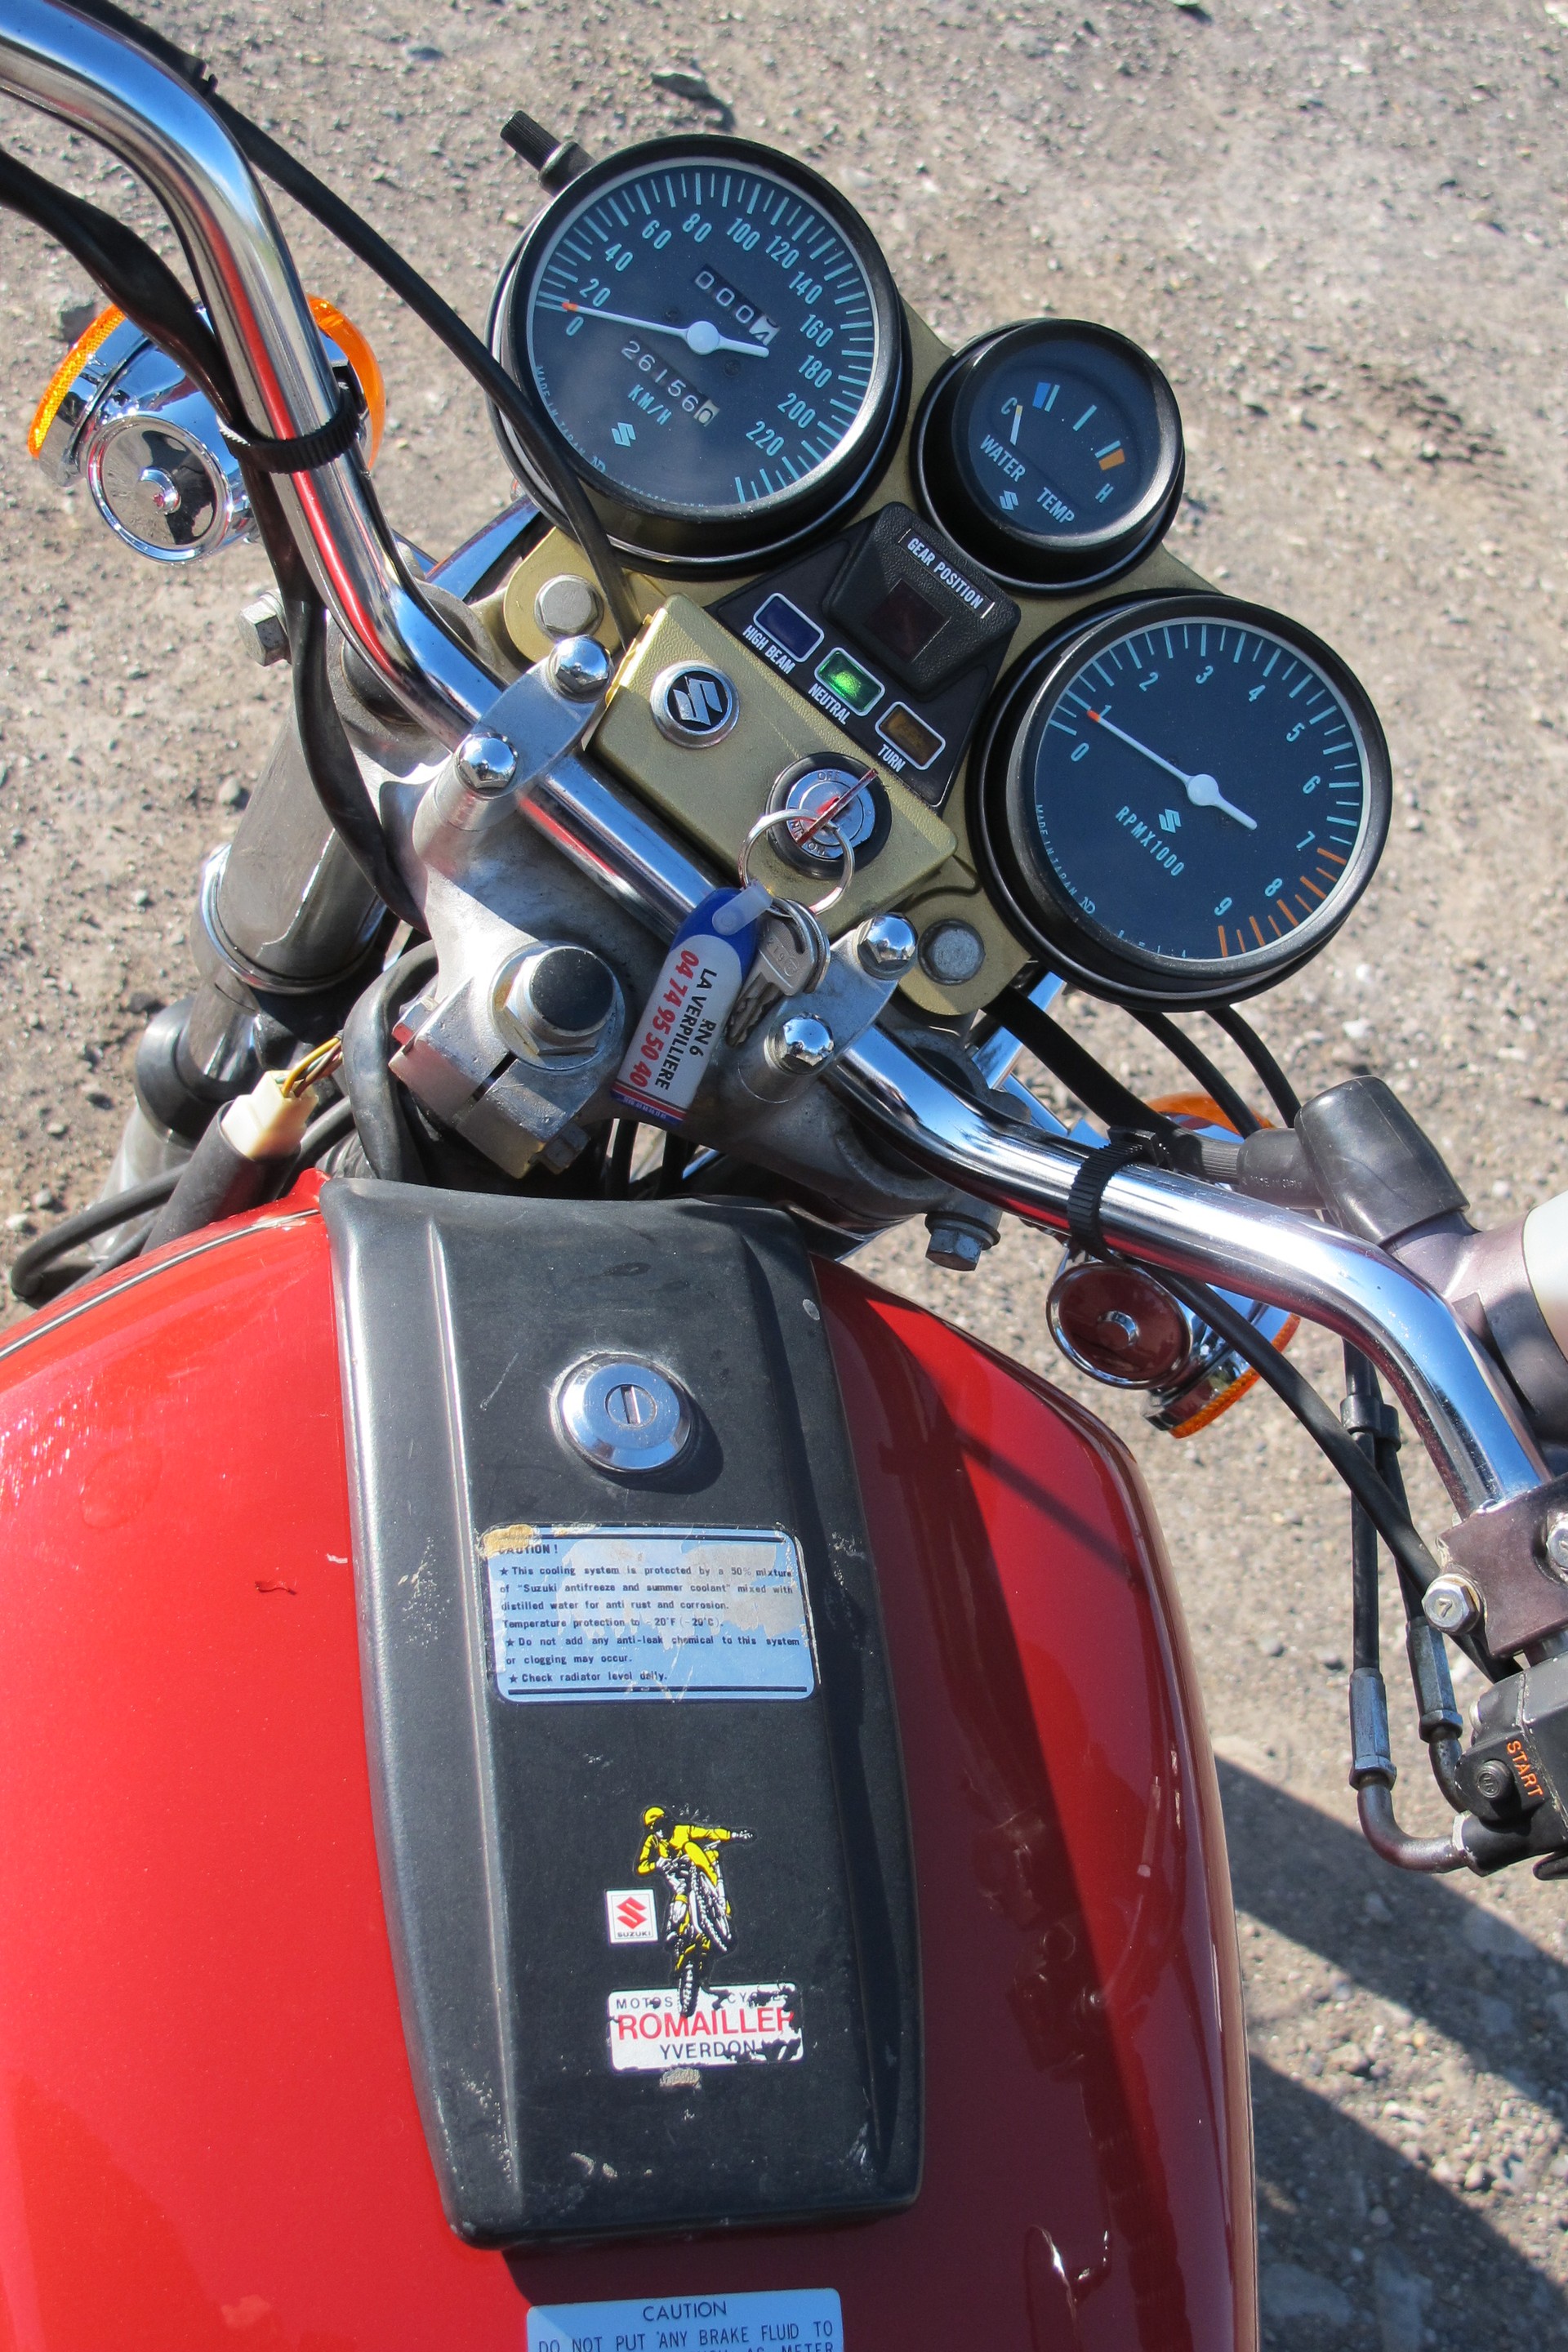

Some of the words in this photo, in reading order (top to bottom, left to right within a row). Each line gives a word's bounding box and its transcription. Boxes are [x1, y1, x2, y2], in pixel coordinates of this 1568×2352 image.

[642, 220, 672, 249] 60
[682, 213, 712, 243] 80
[726, 217, 761, 252] 100
[604, 243, 634, 272] 40
[765, 235, 800, 270] 120
[579, 278, 611, 307] 20
[788, 271, 823, 305] 140
[566, 316, 585, 336] 0
[800, 314, 834, 348] 160
[798, 354, 833, 389] 180
[628, 384, 672, 425] KM/H
[777, 392, 816, 429] 200
[1000, 397, 1018, 415] C
[746, 421, 784, 456] 220
[980, 434, 1026, 483] WATER
[1036, 487, 1075, 523] TEMP
[1095, 483, 1114, 504] H
[906, 537, 935, 567] GEAR
[934, 560, 984, 610] POSITION
[742, 624, 766, 652] HIGH
[764, 646, 796, 675] BEAM
[1138, 671, 1159, 692] 2
[1196, 666, 1214, 684] 3
[808, 683, 851, 726] NEUTRAL
[1248, 684, 1267, 702] 4
[1098, 704, 1112, 719] 1
[1286, 722, 1305, 742] 5
[877, 743, 906, 773] TURN
[1070, 742, 1089, 763] 0
[1303, 775, 1321, 795] 6
[1036, 804, 1049, 835] MADE
[1296, 831, 1316, 850] 7
[1264, 878, 1284, 897] 8
[1214, 897, 1233, 916] 9
[675, 949, 700, 979] 04
[663, 978, 688, 1007] 74
[697, 968, 718, 990] LA
[652, 1006, 676, 1036] 95
[702, 1019, 717, 1046] RN
[640, 1032, 665, 1061] 50
[655, 995, 707, 1091] VERPILLIERE
[689, 1045, 704, 1058] 6
[629, 1060, 653, 1089] 40
[511, 1566, 534, 1575] This
[539, 1566, 576, 1576] cooling
[584, 1566, 620, 1575] system
[627, 1566, 636, 1575] is
[644, 1566, 692, 1575] protected
[699, 1566, 710, 1576] by
[731, 1567, 751, 1576] 50%
[755, 1568, 792, 1577] mixture
[500, 1584, 510, 1592] of
[564, 1584, 616, 1592] antifreeze
[623, 1583, 639, 1592] and
[737, 1584, 766, 1593] mixed
[773, 1585, 793, 1594] with
[501, 1601, 544, 1610] distilled
[550, 1601, 579, 1610] water
[585, 1601, 599, 1609] for
[606, 1600, 625, 1609] anti
[630, 1601, 652, 1609] rust
[657, 1601, 675, 1609] and
[680, 1601, 729, 1610] corrosion.
[1438, 1597, 1453, 1618] 7
[502, 1619, 567, 1629] Temperature
[573, 1618, 625, 1628] protection
[630, 1618, 640, 1627] to
[519, 1637, 532, 1646] Do
[540, 1637, 556, 1646] not
[565, 1636, 583, 1646] add
[592, 1637, 609, 1646] any
[617, 1635, 663, 1645] anti-leak
[671, 1635, 714, 1645] chemical
[722, 1636, 733, 1645] to
[737, 1636, 756, 1645] this
[766, 1637, 800, 1646] system
[506, 1657, 516, 1665] or
[523, 1655, 567, 1666] clogging
[573, 1655, 594, 1664] may
[601, 1655, 633, 1663] occur.
[521, 1673, 553, 1682] Check
[559, 1672, 601, 1682] radiator
[608, 1671, 632, 1681] level
[1506, 1740, 1544, 1797] START
[660, 2039, 756, 2060] YVERDON
[643, 2301, 727, 2322] CAUTION
[538, 2339, 560, 2352] DO
[572, 2336, 603, 2352] NOT
[616, 2333, 645, 2351] PUT
[658, 2331, 688, 2349] ANY
[699, 2327, 749, 2345] BRAKE
[761, 2323, 799, 2341] FLUID
[813, 2320, 833, 2337] TO
